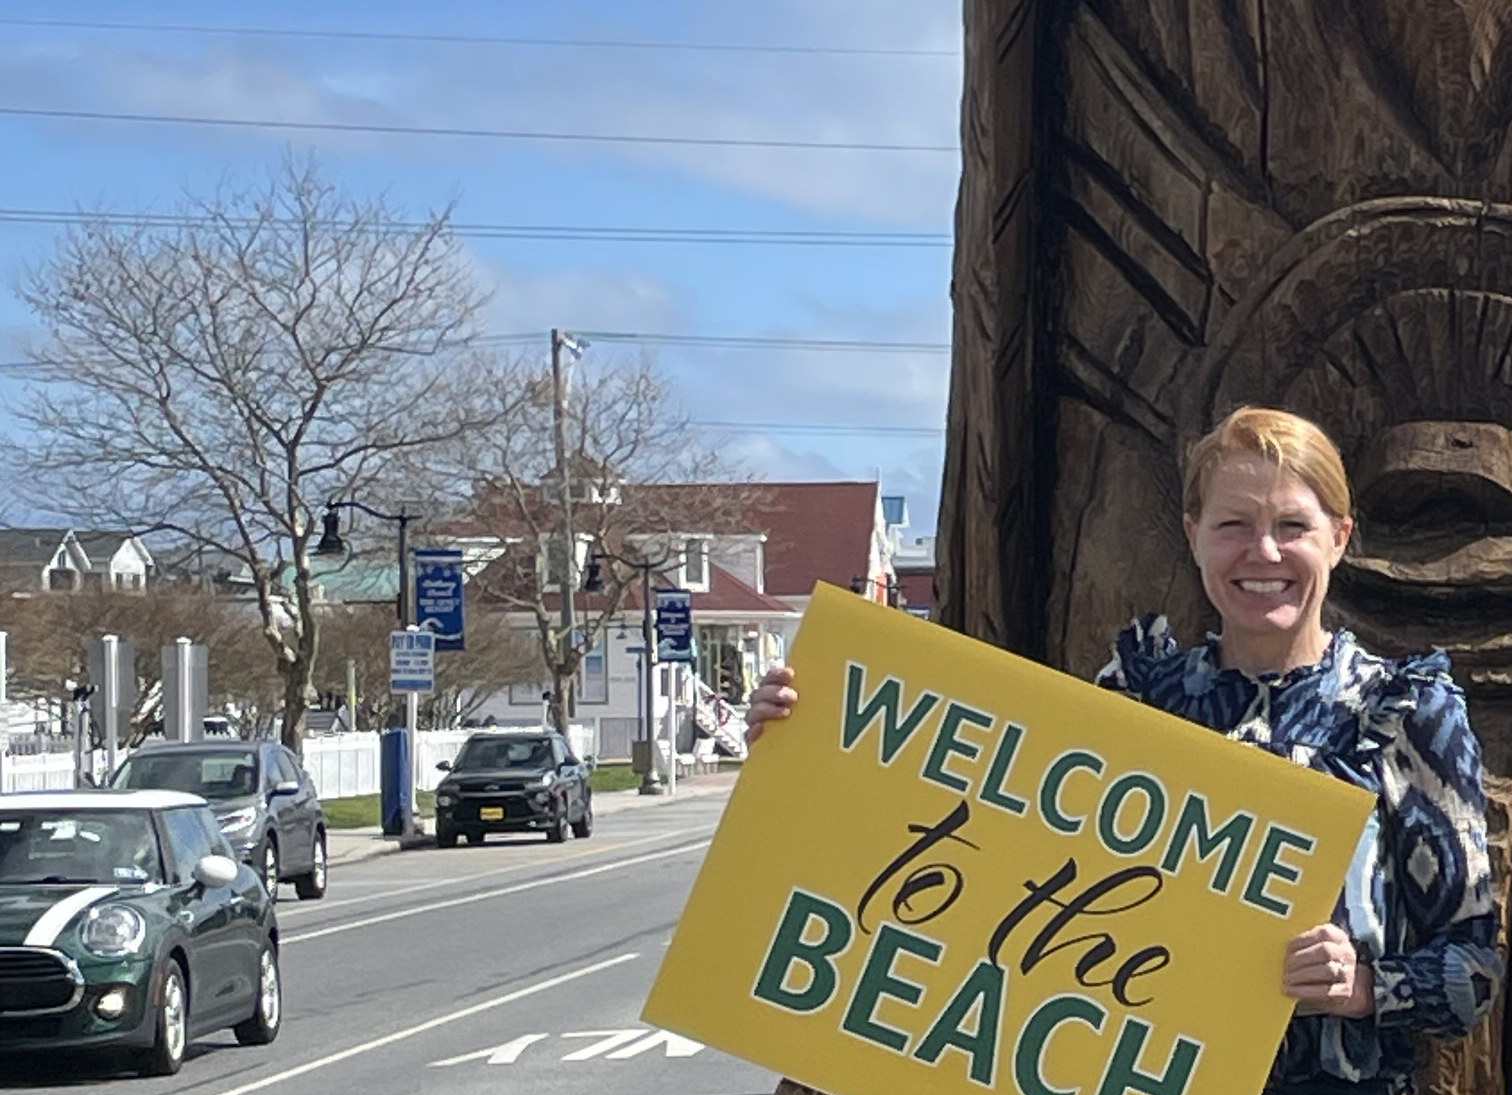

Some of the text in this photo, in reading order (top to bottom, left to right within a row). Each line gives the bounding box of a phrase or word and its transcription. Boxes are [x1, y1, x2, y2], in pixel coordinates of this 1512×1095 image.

[840, 659, 1316, 917] WELCOME
[857, 800, 1170, 1007] to the
[426, 1029, 707, 1066] NLY
